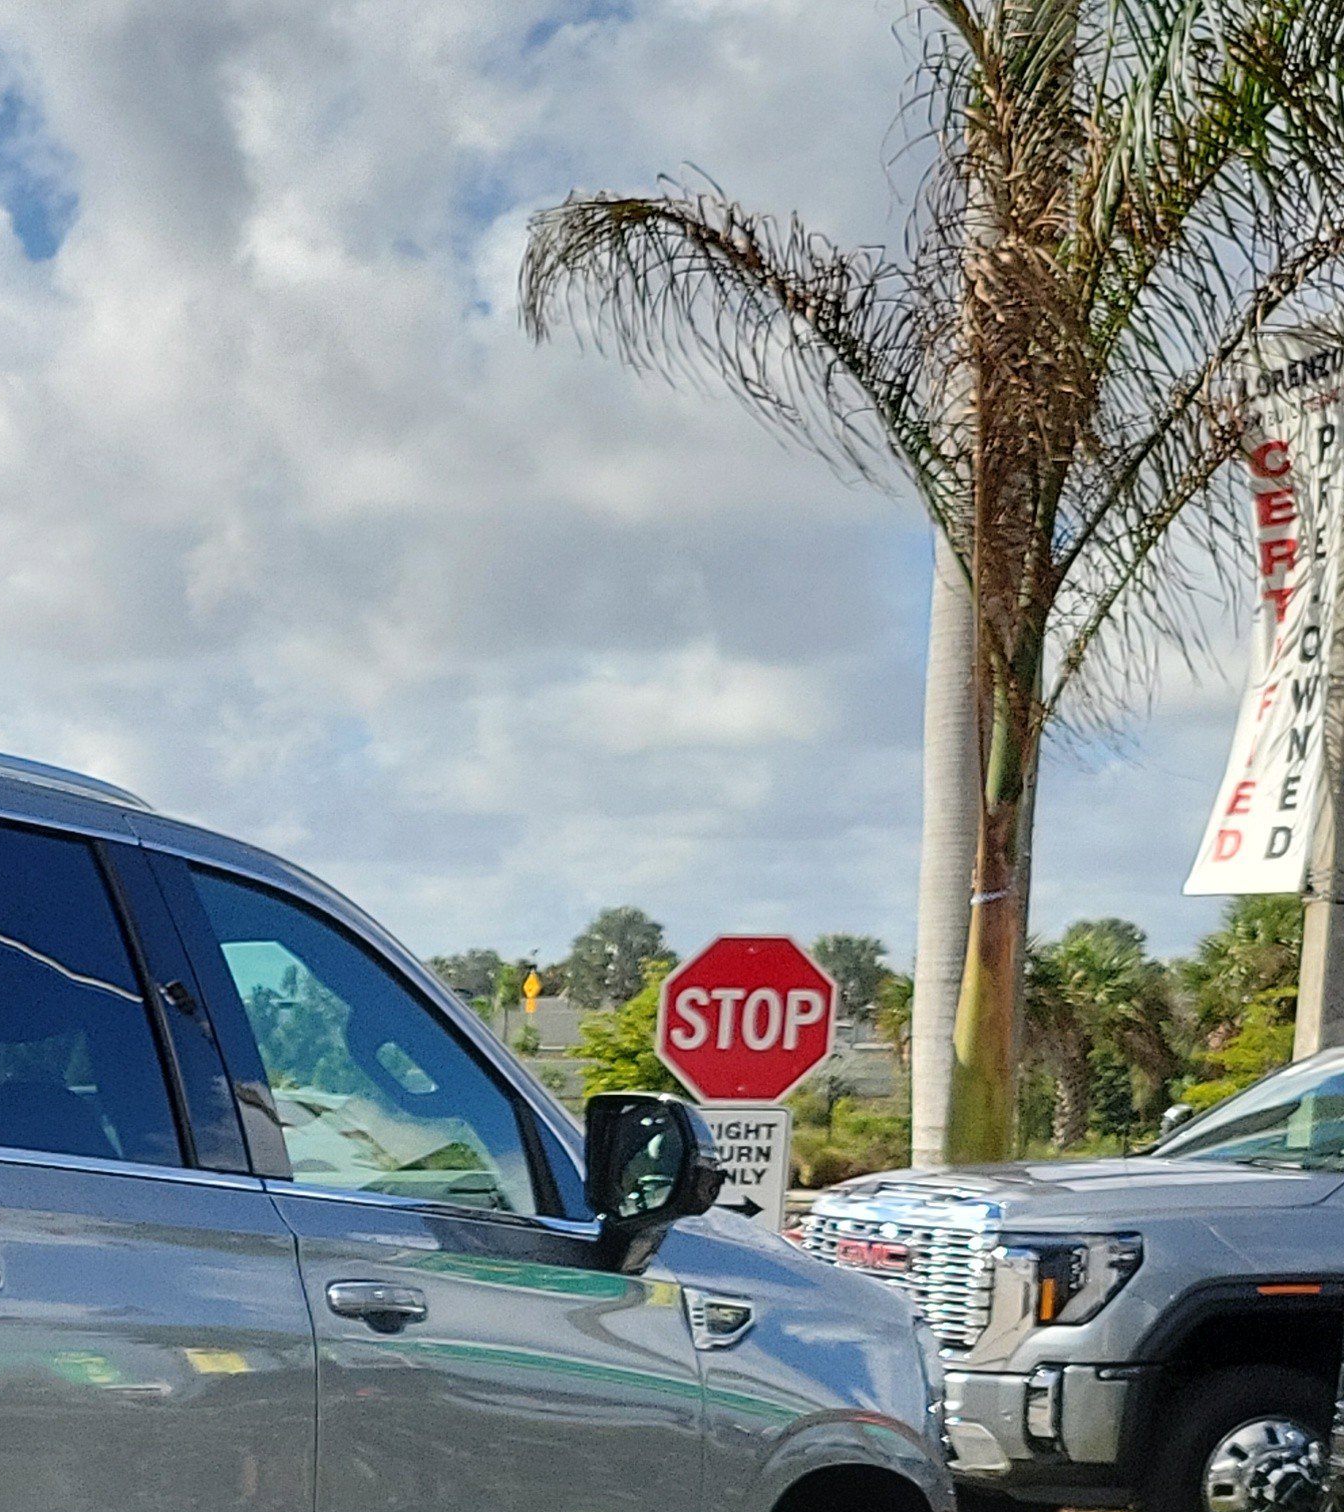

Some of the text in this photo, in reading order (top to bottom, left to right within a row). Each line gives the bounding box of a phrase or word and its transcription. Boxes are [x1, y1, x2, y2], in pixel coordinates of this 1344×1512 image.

[670, 987, 825, 1051] STOP
[711, 1122, 777, 1140] IGHT
[717, 1145, 771, 1163] URN
[722, 1167, 767, 1186] NLY
